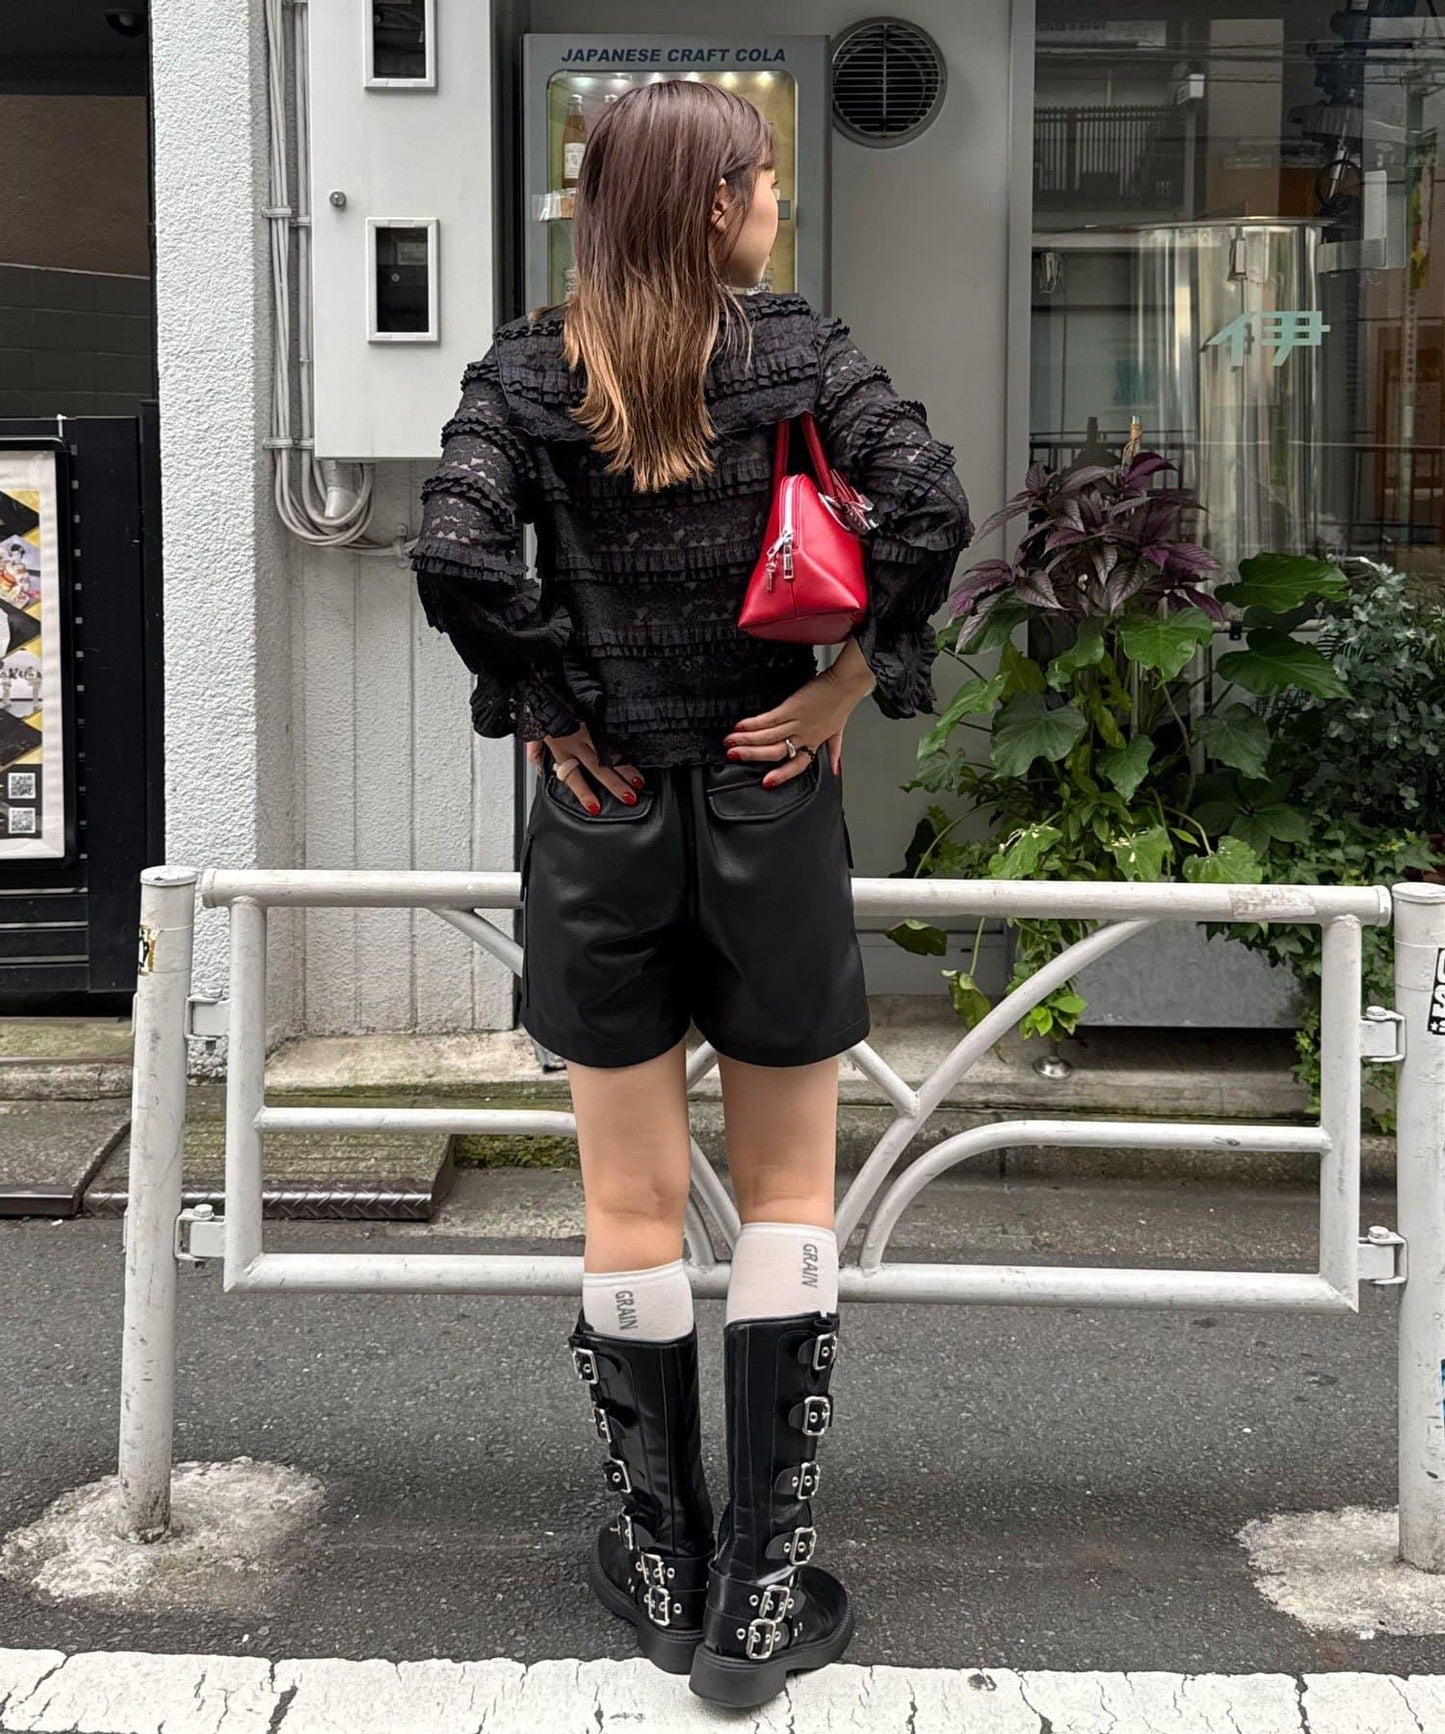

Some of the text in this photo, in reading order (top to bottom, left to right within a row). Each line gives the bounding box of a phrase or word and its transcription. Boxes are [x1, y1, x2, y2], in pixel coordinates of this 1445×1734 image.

[560, 48, 786, 63] JAPANESE CRAFT COLA
[801, 1243, 819, 1289] GRAIN
[615, 1290, 638, 1331] GRAIN
